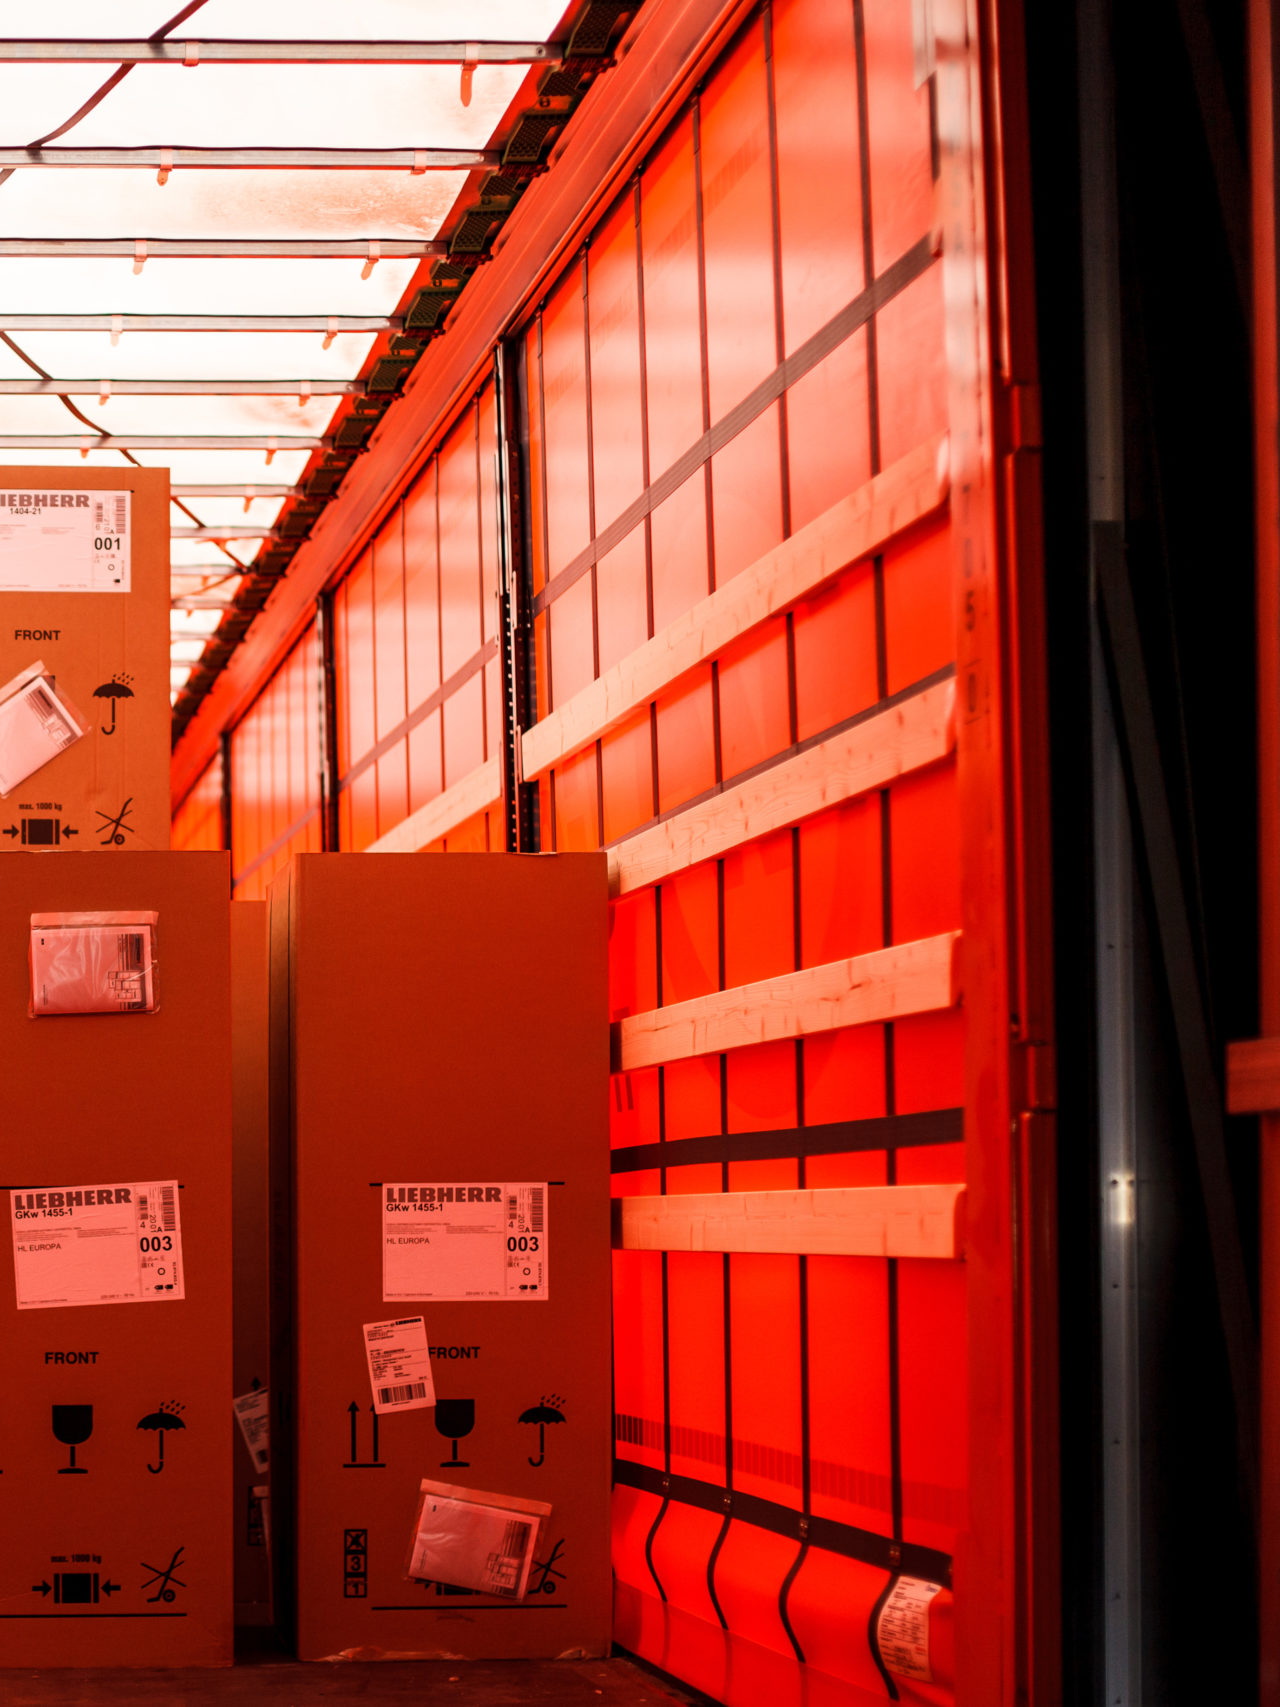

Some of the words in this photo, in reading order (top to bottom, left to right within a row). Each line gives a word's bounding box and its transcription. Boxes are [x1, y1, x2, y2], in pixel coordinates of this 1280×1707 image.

[9, 507, 42, 515] 1404-21
[94, 537, 121, 551] 001
[13, 629, 62, 641] FRONT
[36, 802, 53, 810] 1000
[54, 802, 62, 811] kg
[14, 1188, 132, 1210] LIEBHERR
[386, 1187, 502, 1203] LIEBHERR
[15, 1210, 39, 1220] GKw
[41, 1207, 73, 1217] 1455-1
[386, 1203, 410, 1212] GKw
[412, 1203, 444, 1212] 1455-1
[29, 1243, 62, 1251] EUROPA
[140, 1236, 173, 1252] 003
[507, 1236, 540, 1252] 003
[44, 1351, 99, 1365] FRONT
[428, 1346, 481, 1359] FRONT
[92, 1554, 101, 1564] kg
[351, 1556, 361, 1571] 3
